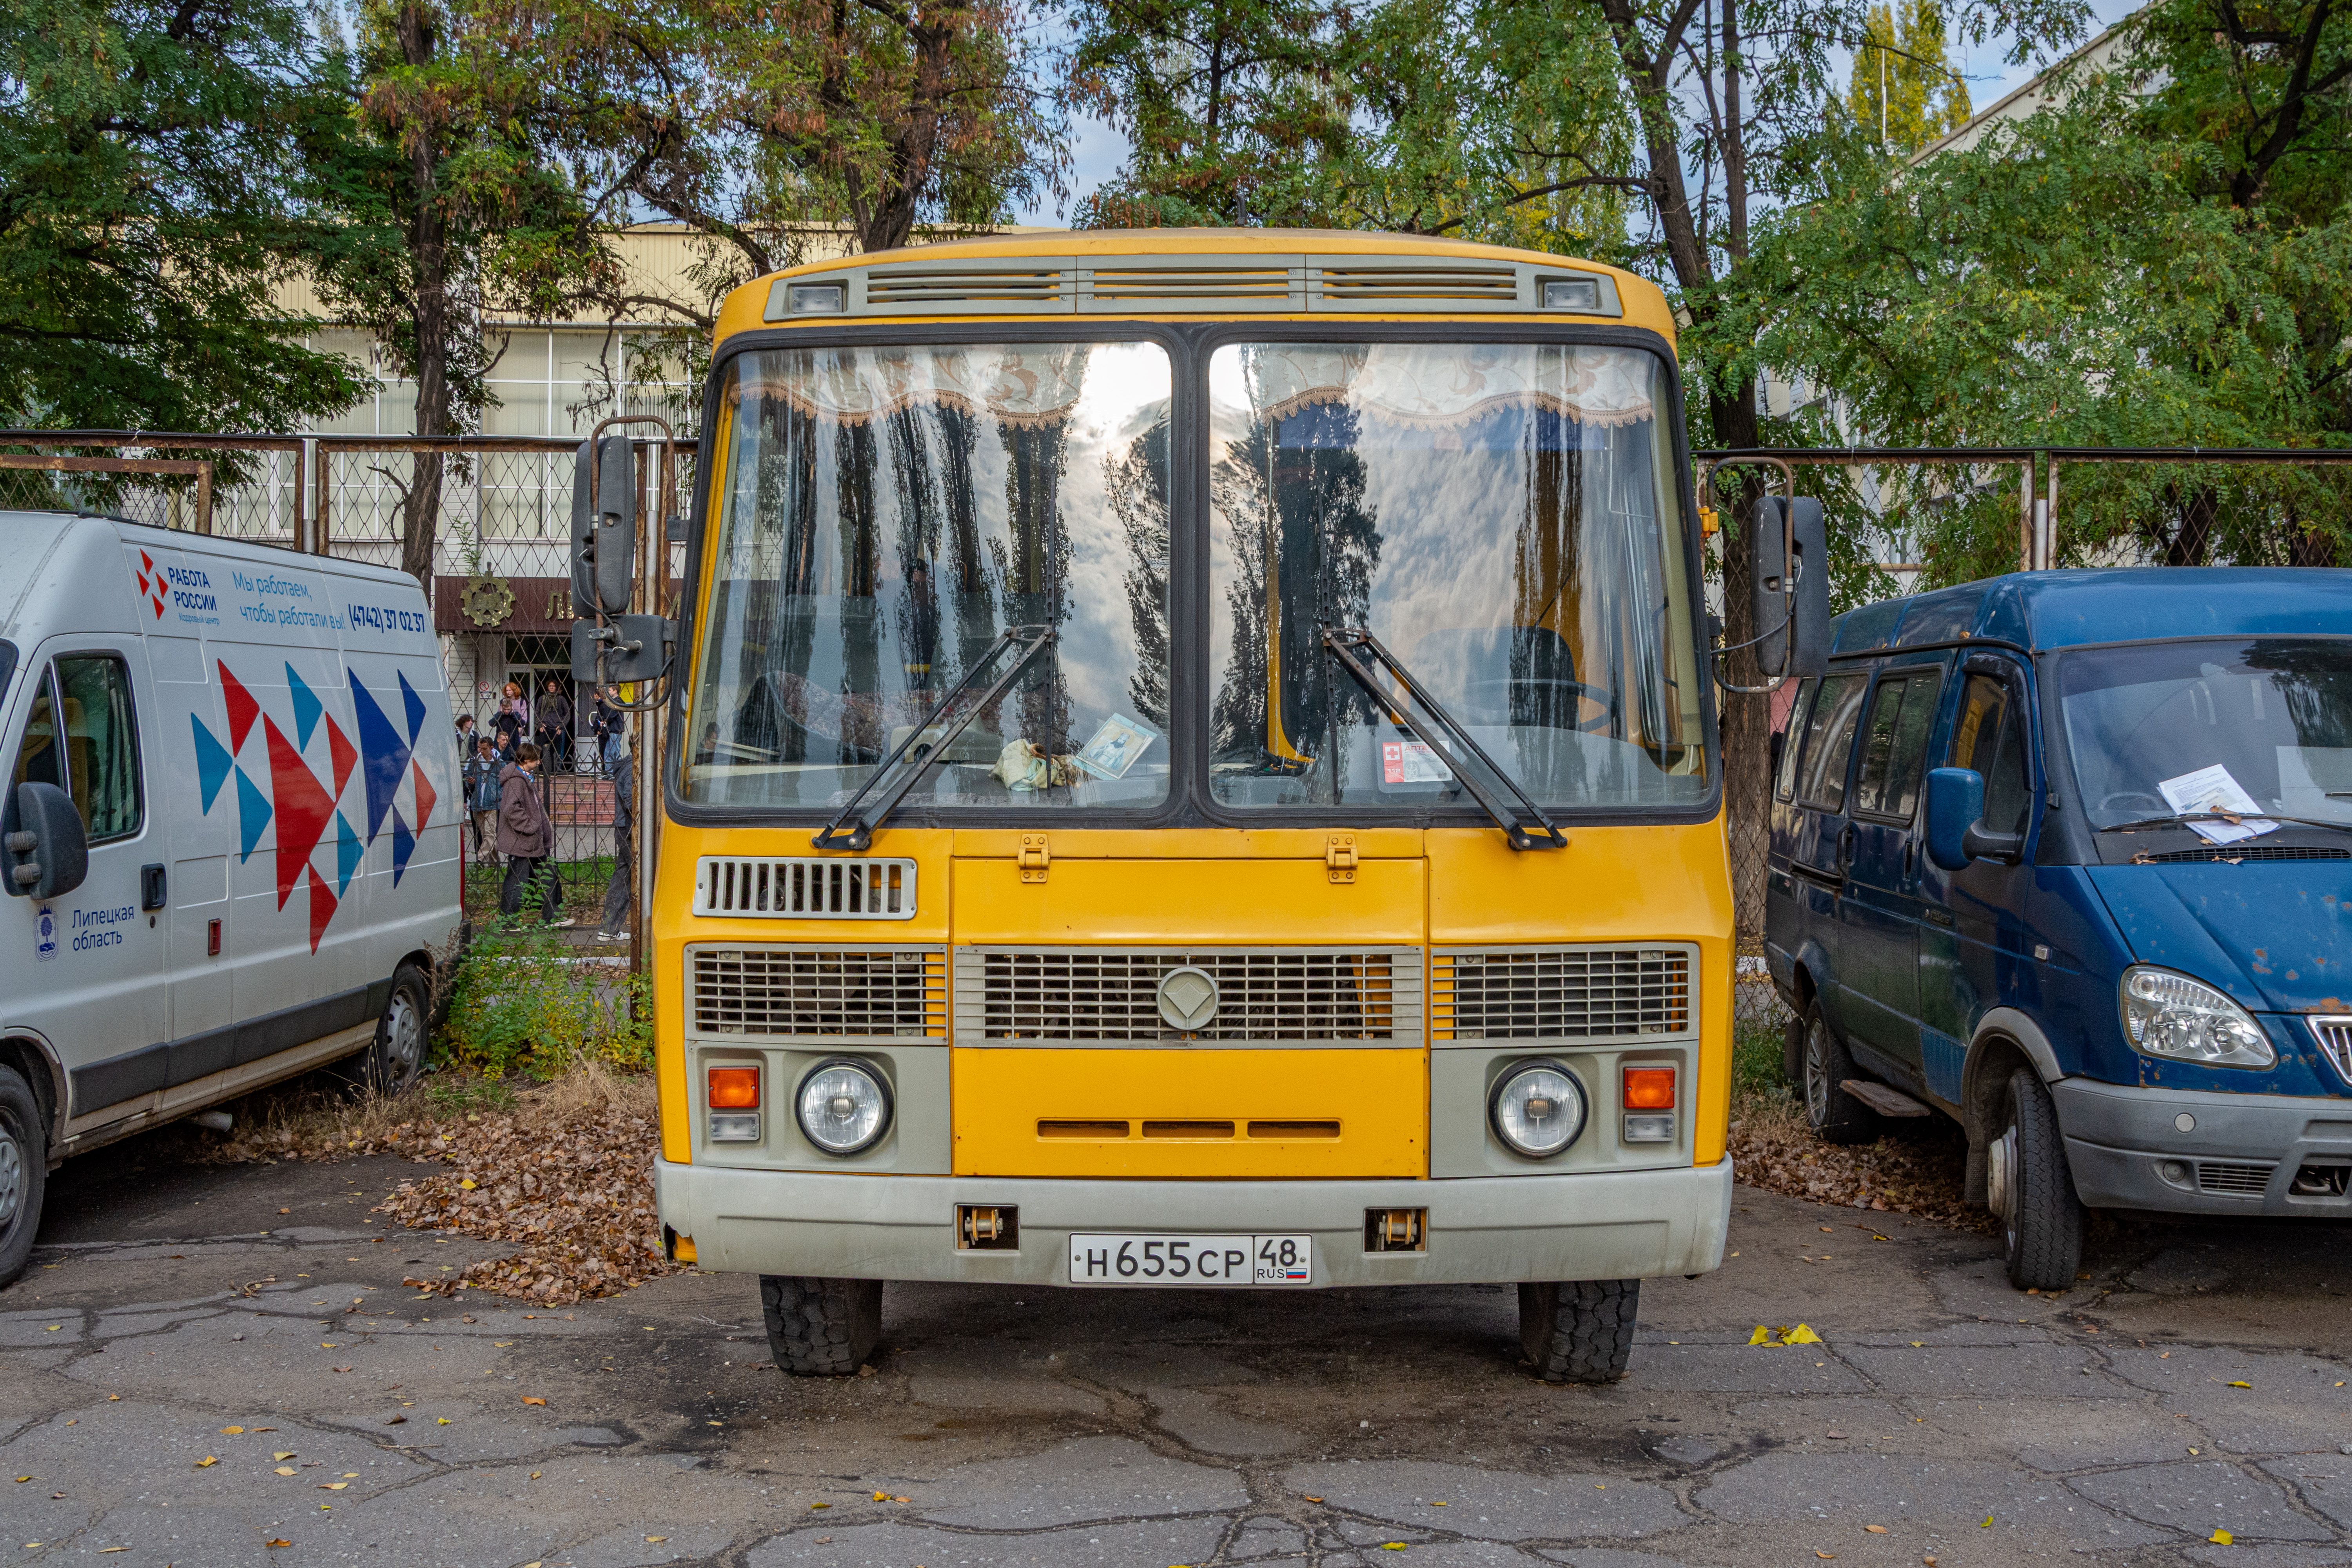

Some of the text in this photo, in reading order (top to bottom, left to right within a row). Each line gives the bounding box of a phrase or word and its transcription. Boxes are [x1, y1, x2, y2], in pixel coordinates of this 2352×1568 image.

[168, 567, 211, 588] РАБОТА
[232, 571, 312, 602] Мы работаем,
[174, 590, 217, 611] РОССИИ
[240, 602, 346, 630] чтобы работали вы!
[348, 604, 425, 633] (4742) 37 02 37
[72, 906, 134, 929] Липецкая
[73, 930, 122, 951] область
[1259, 1239, 1297, 1267] 48
[1257, 1269, 1285, 1279] RUS
